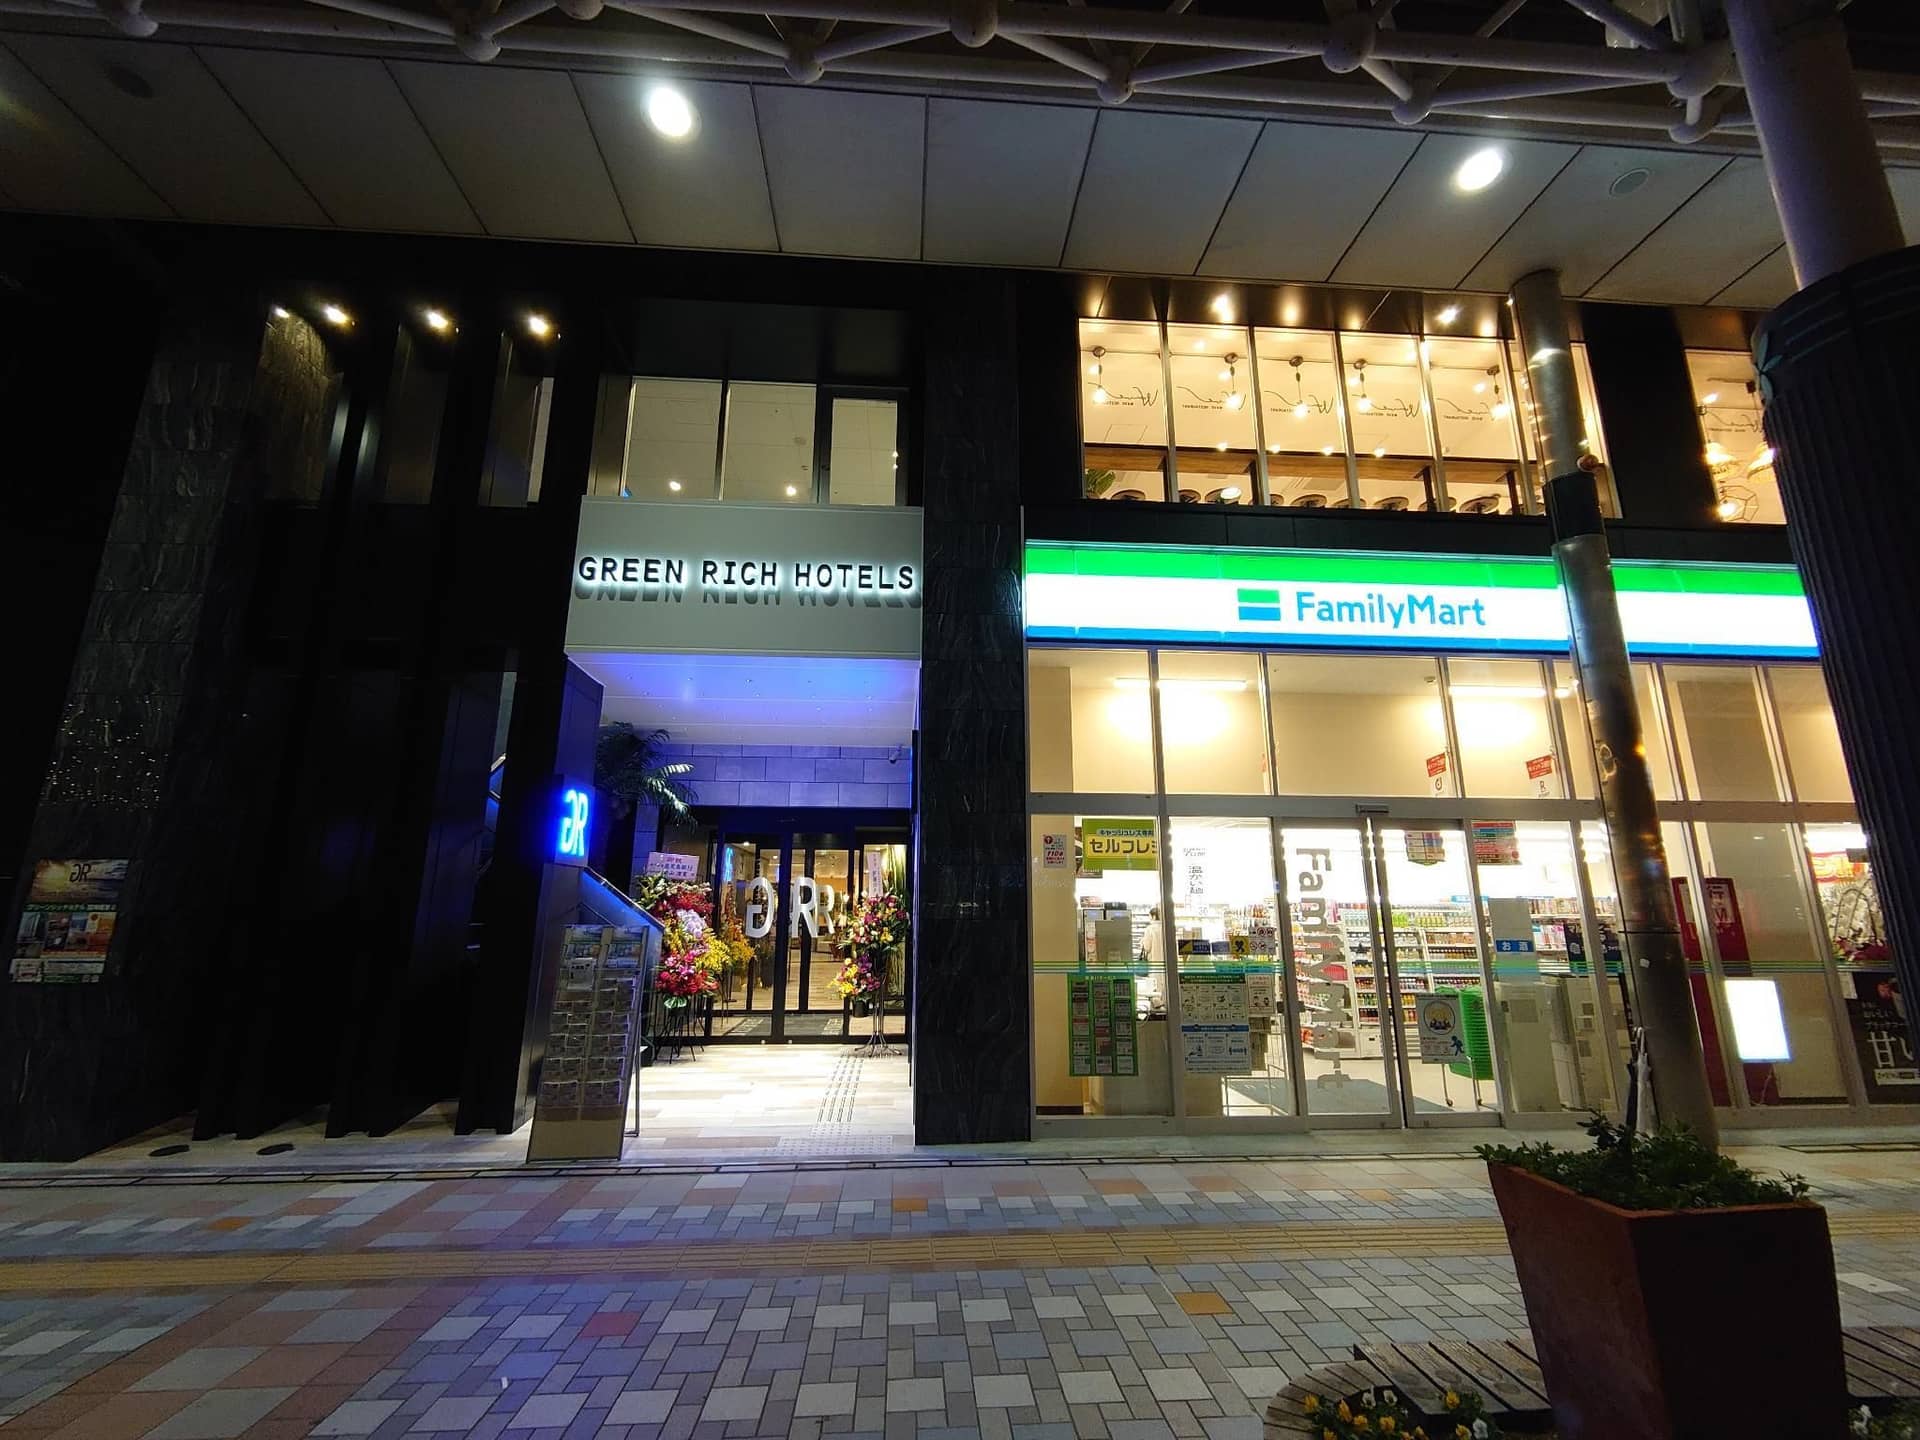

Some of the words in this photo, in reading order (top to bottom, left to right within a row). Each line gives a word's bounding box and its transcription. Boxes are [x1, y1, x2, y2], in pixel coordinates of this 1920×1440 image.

[578, 556, 683, 584] GREEN
[702, 560, 777, 586] RICH
[795, 563, 914, 590] HOTELS
[1295, 591, 1486, 629] FamilyMart
[1295, 847, 1354, 1090] FamilyMart
